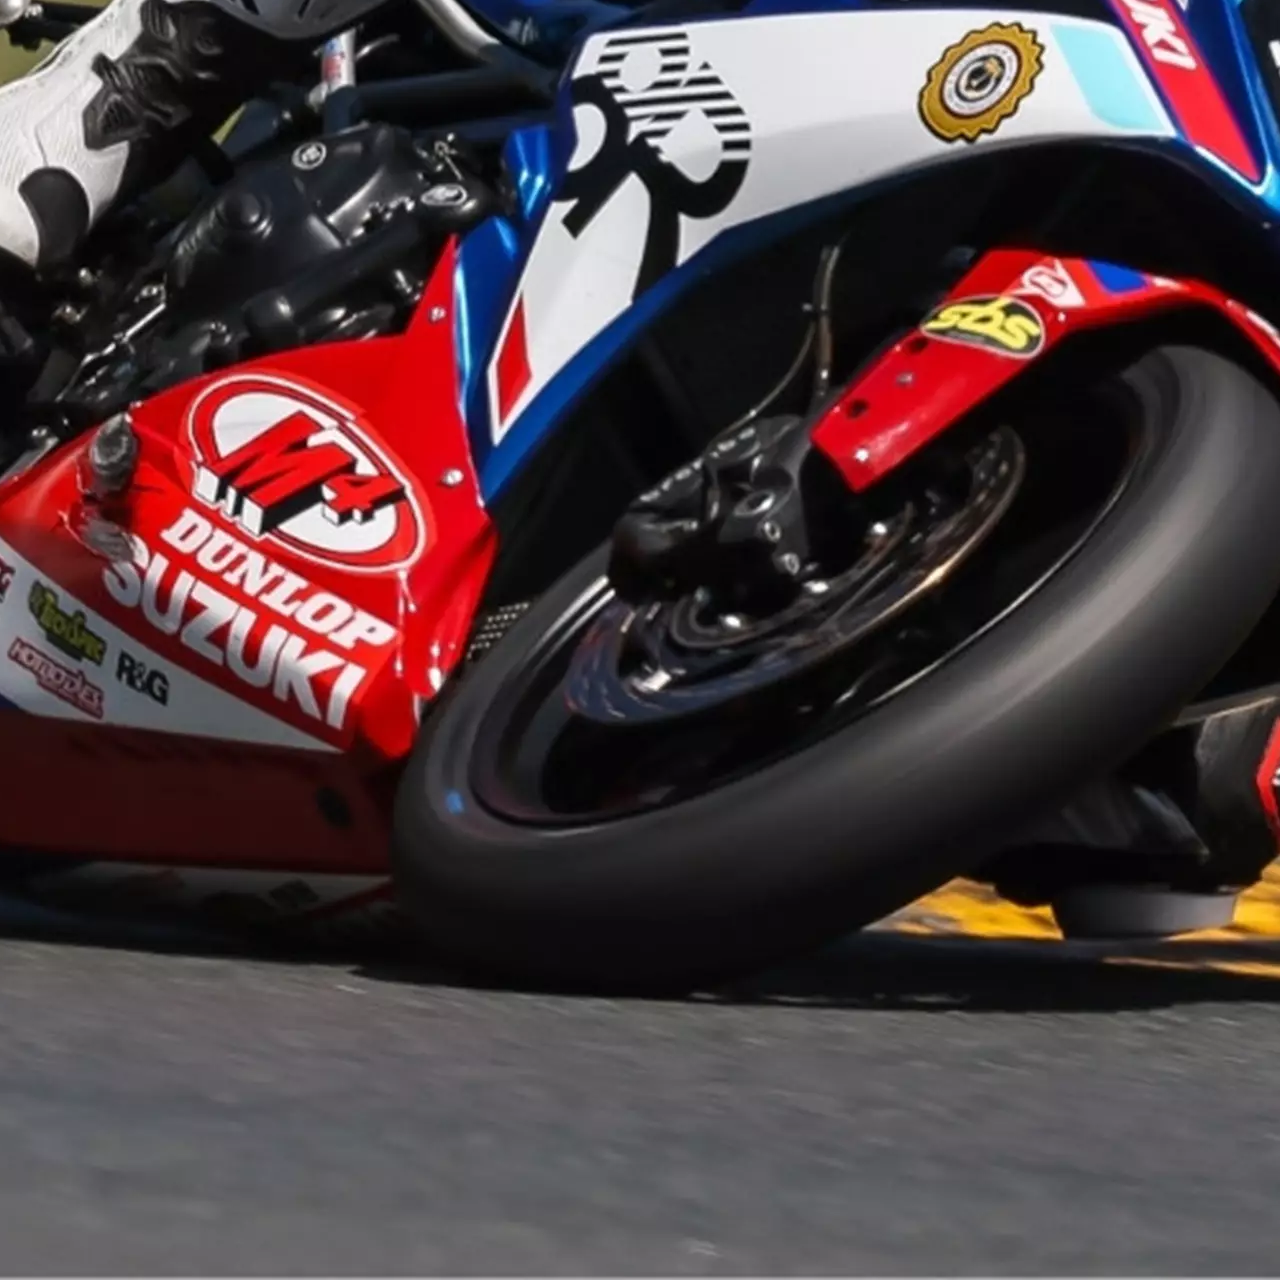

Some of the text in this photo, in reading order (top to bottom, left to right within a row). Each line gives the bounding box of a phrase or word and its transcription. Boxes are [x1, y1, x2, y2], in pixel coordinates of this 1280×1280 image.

[923, 296, 1042, 350] sbs
[195, 409, 404, 538] M4
[103, 533, 367, 731] SUZUKI
[160, 507, 398, 650] DUNLOP
[116, 650, 169, 706] R&G
